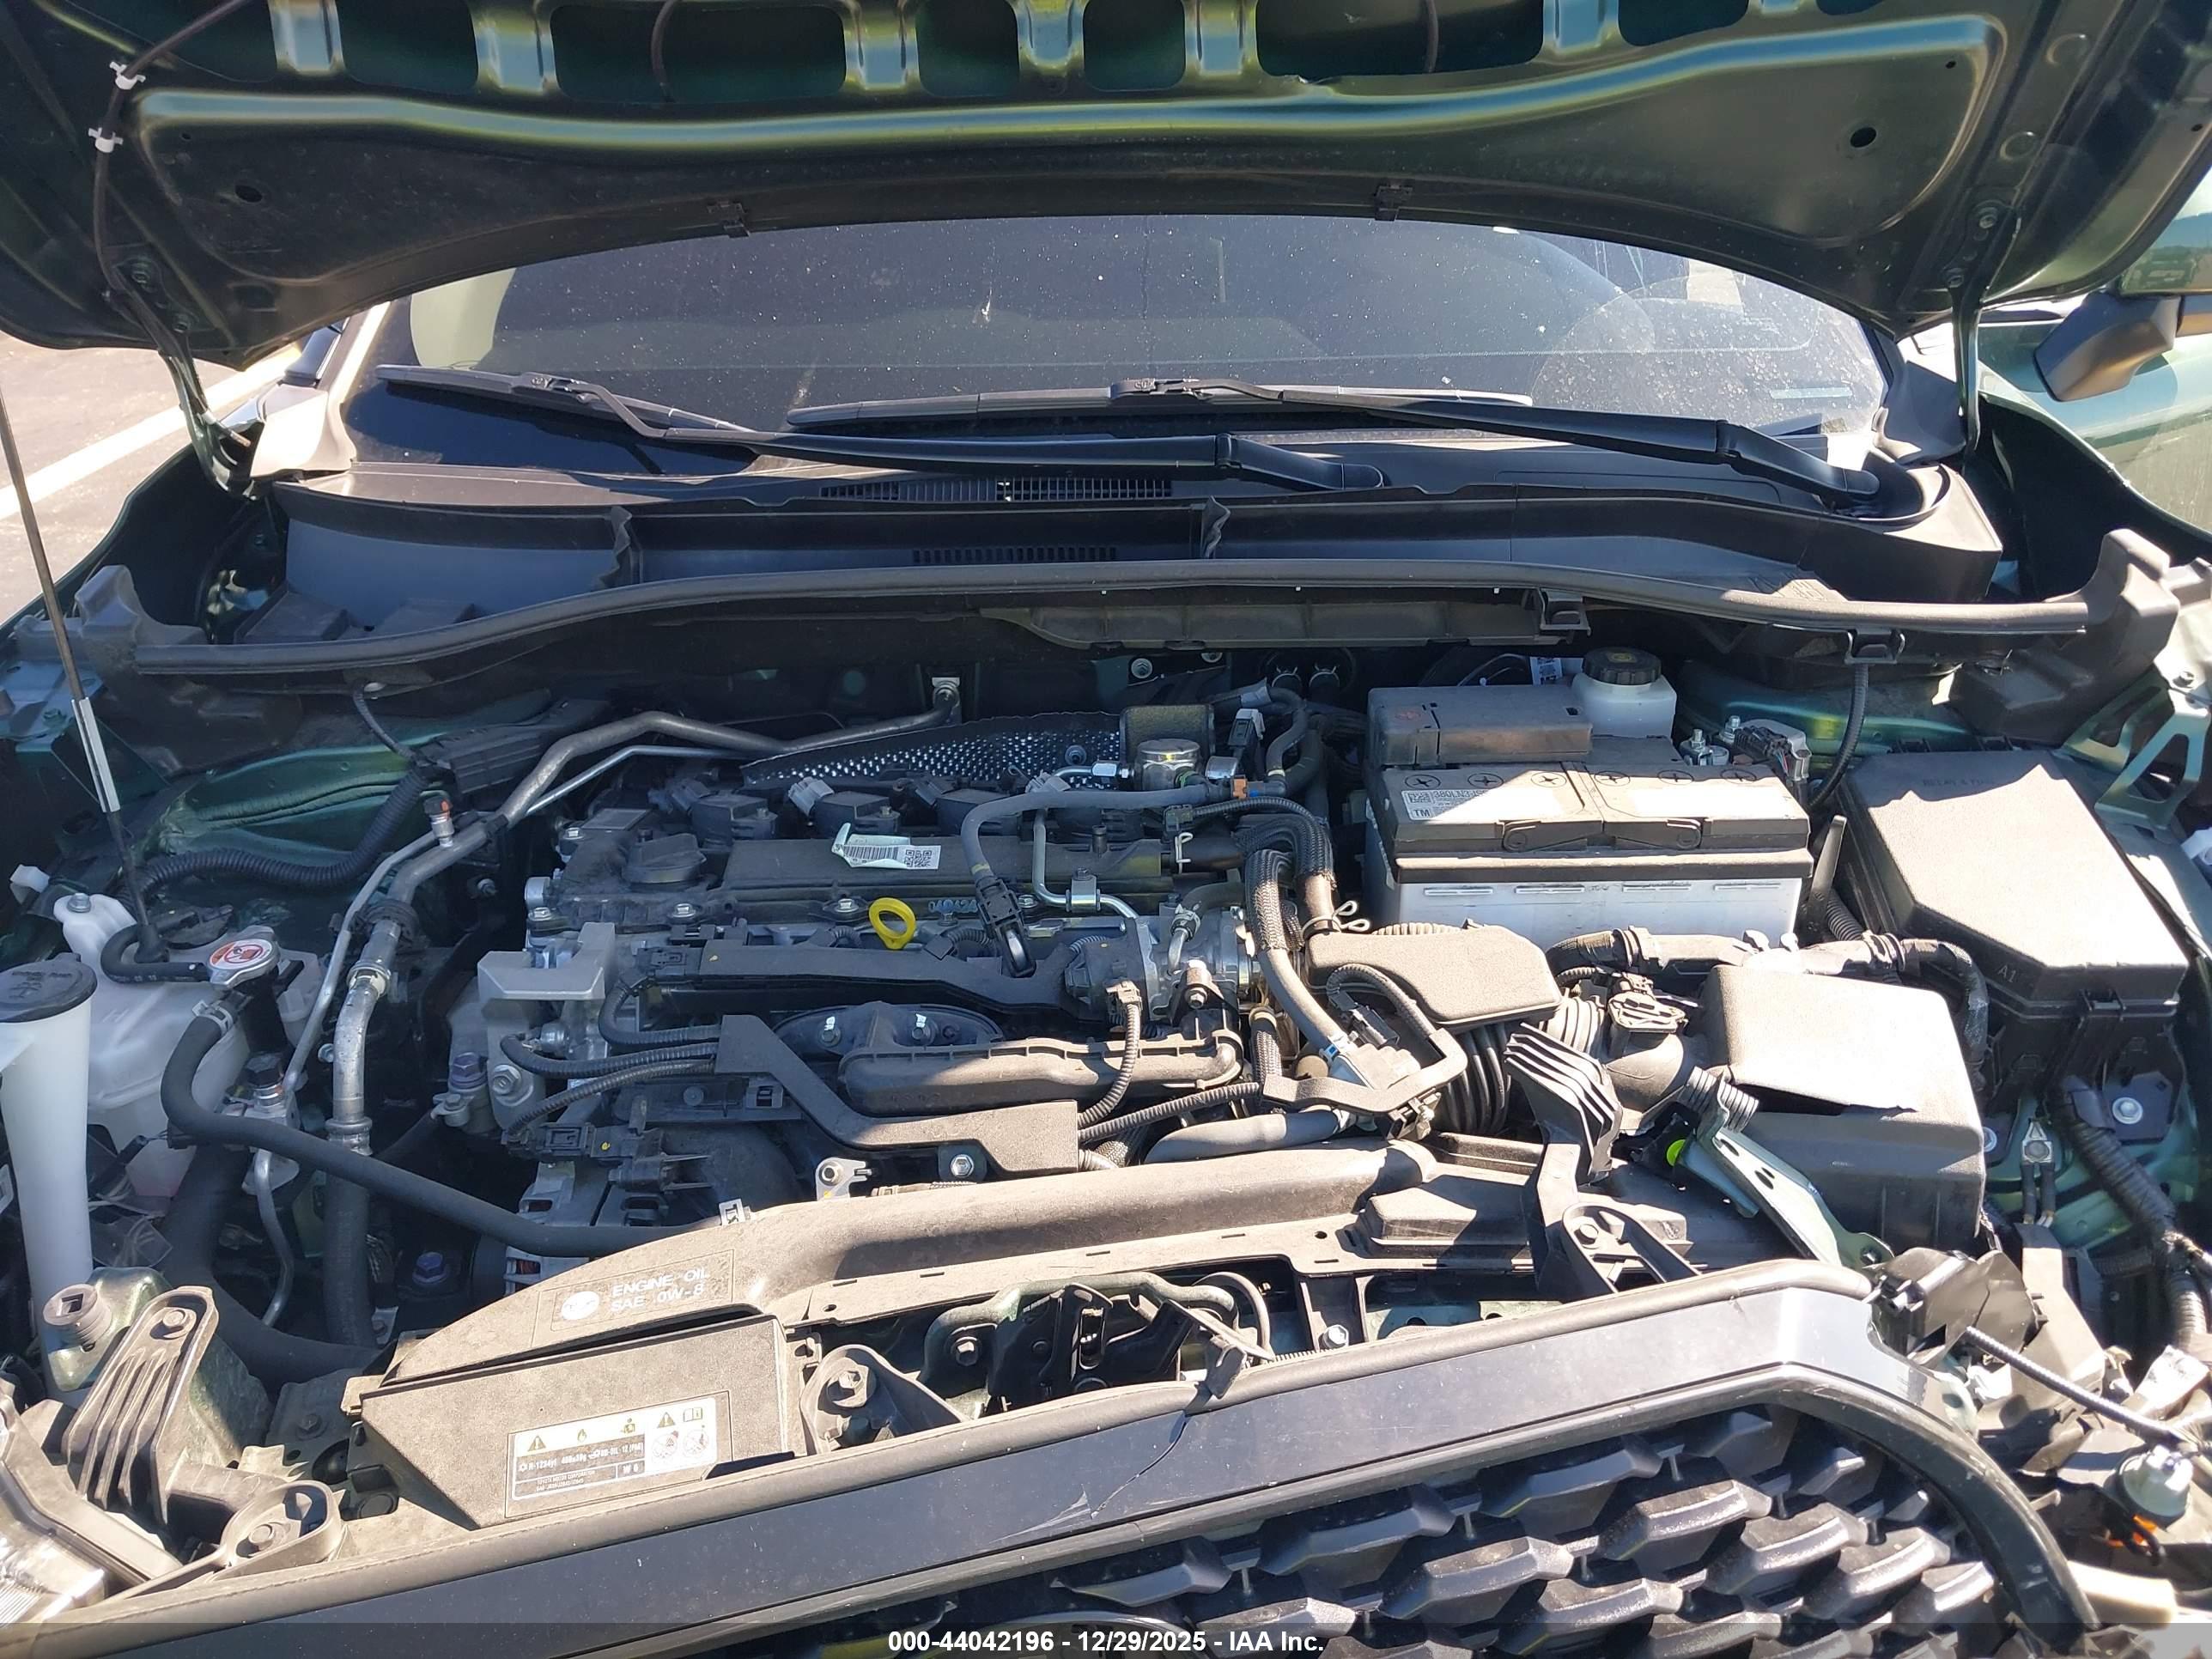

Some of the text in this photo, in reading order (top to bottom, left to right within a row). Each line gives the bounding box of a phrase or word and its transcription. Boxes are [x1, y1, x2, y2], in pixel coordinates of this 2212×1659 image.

[612, 1267, 708, 1297] ENGINE OIL
[611, 1296, 646, 1312] SAE
